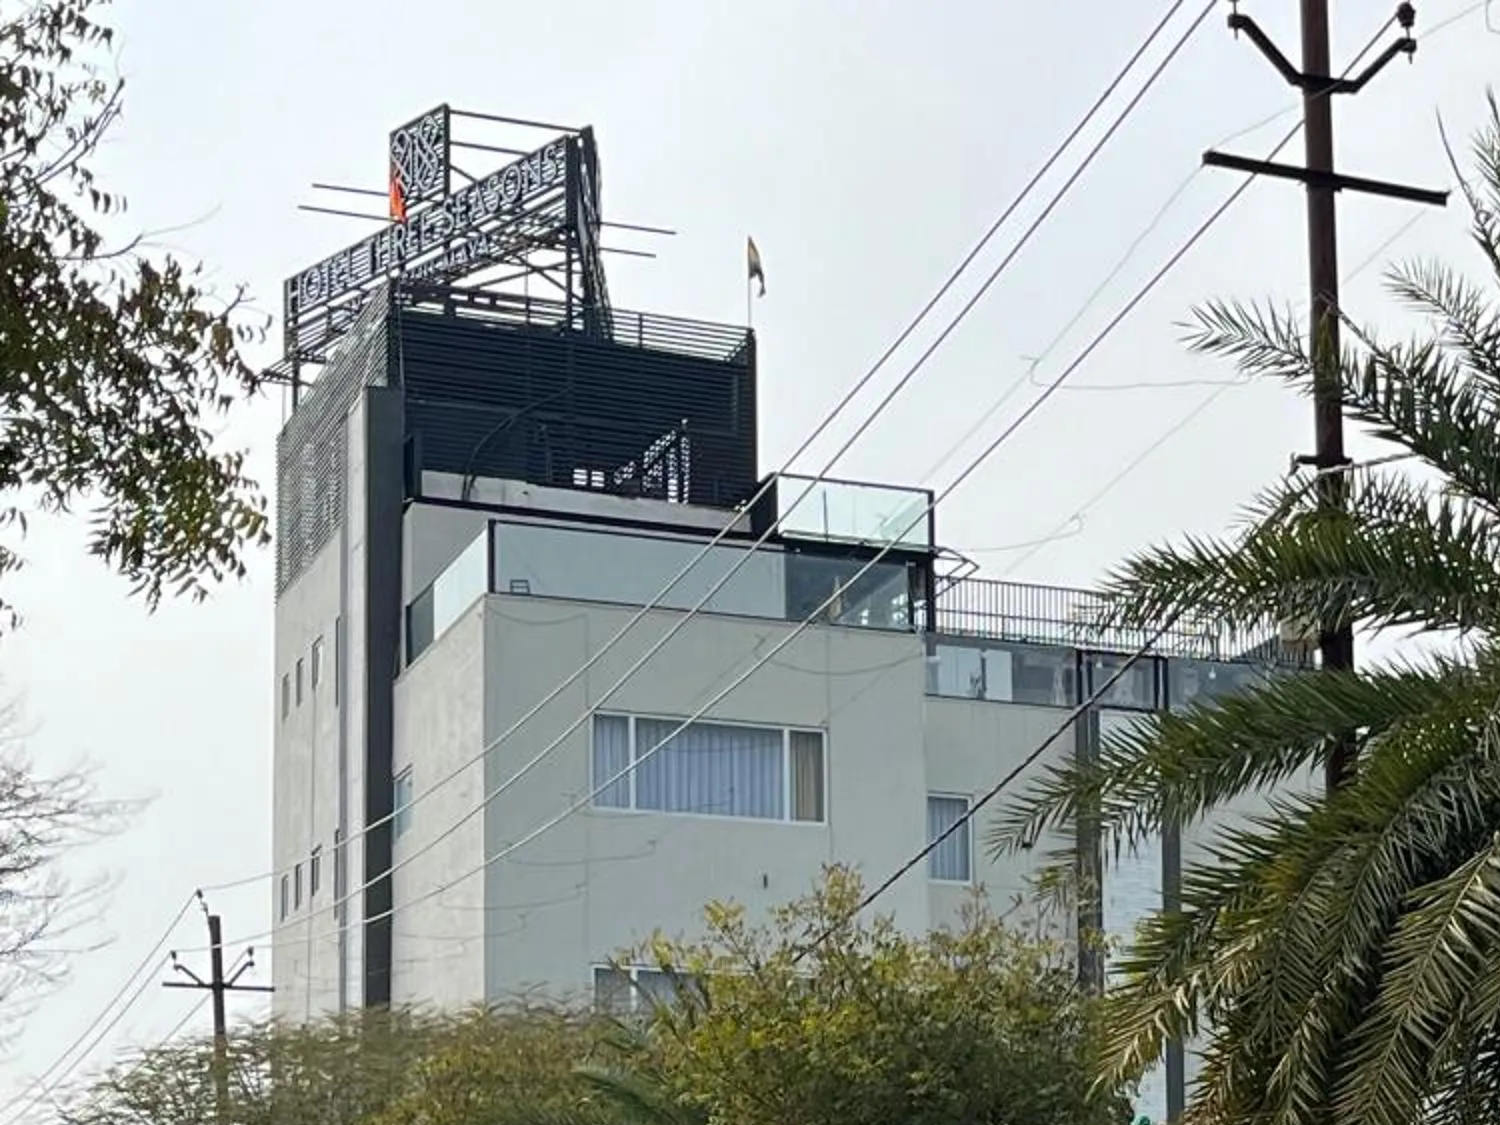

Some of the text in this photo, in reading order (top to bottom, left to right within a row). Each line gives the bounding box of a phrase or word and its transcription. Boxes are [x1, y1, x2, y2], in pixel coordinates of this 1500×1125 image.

[286, 143, 558, 318] HOTEL THREE SEASONS
